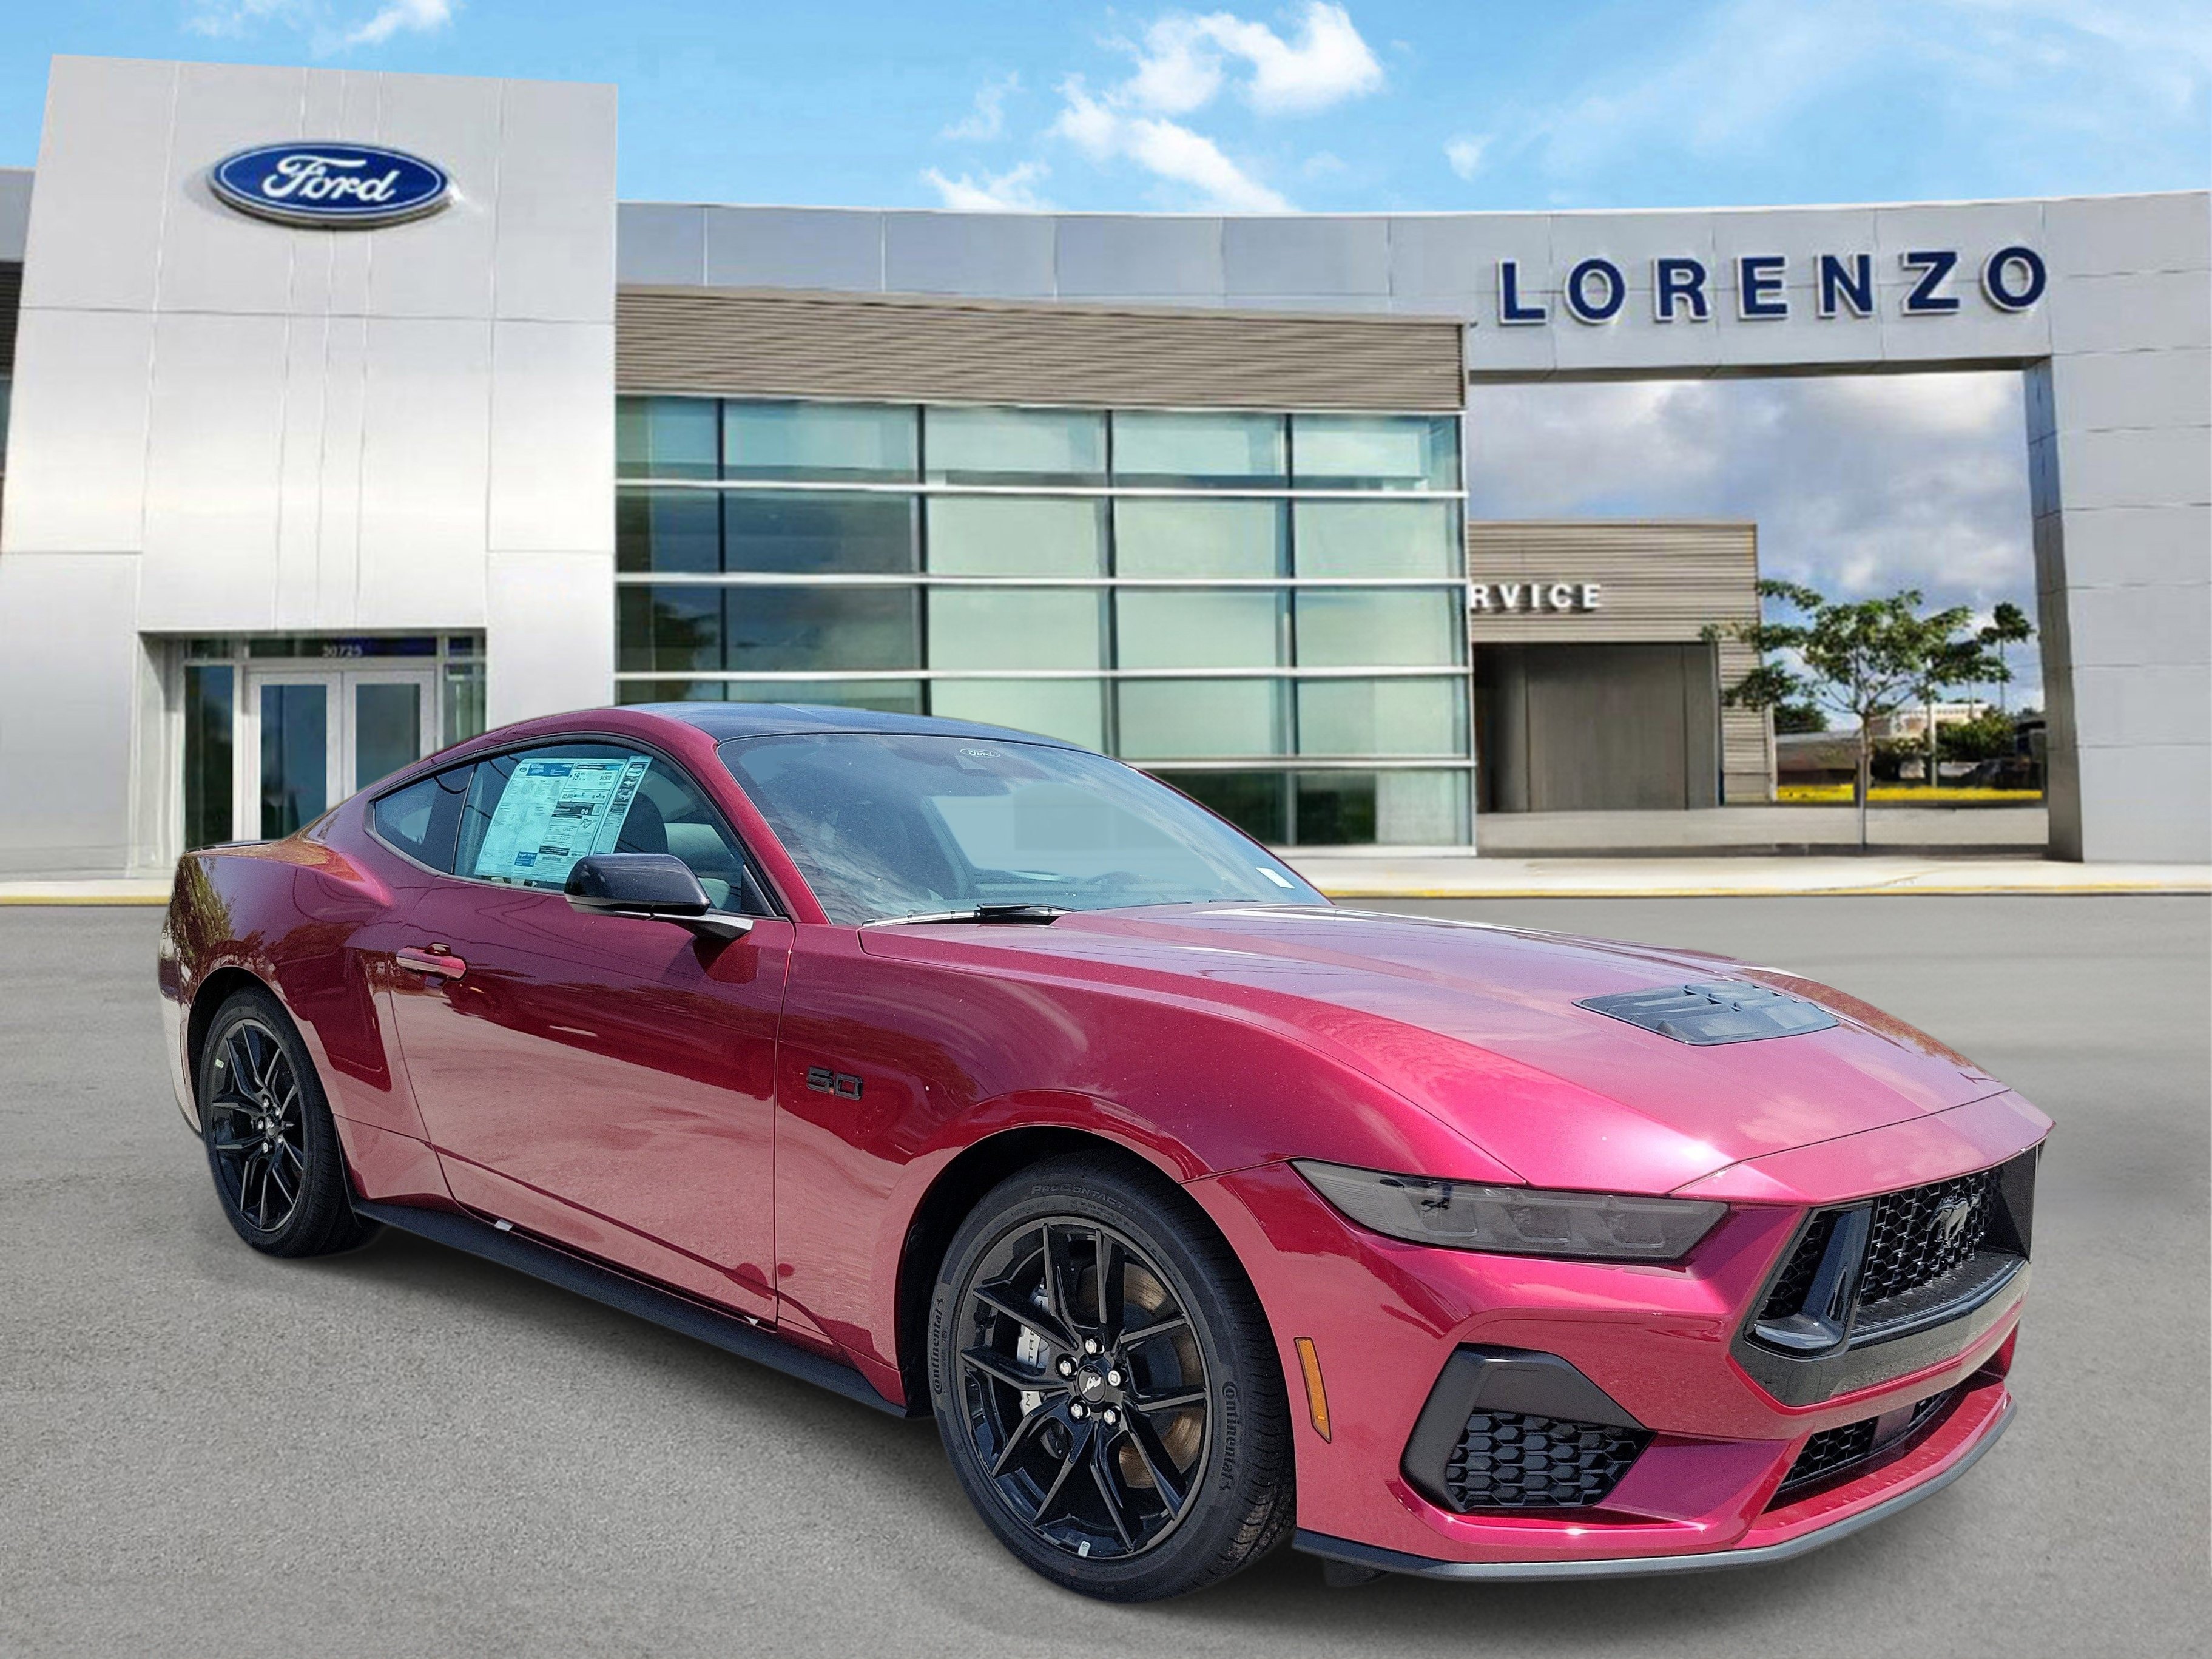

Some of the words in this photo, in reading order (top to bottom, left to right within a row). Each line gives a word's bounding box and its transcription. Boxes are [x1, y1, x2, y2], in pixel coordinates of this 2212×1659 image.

[263, 155, 400, 202] Ford
[1497, 246, 2049, 325] LORENZO
[932, 1308, 943, 1395] Continental
[1221, 1381, 1240, 1481] Continental
